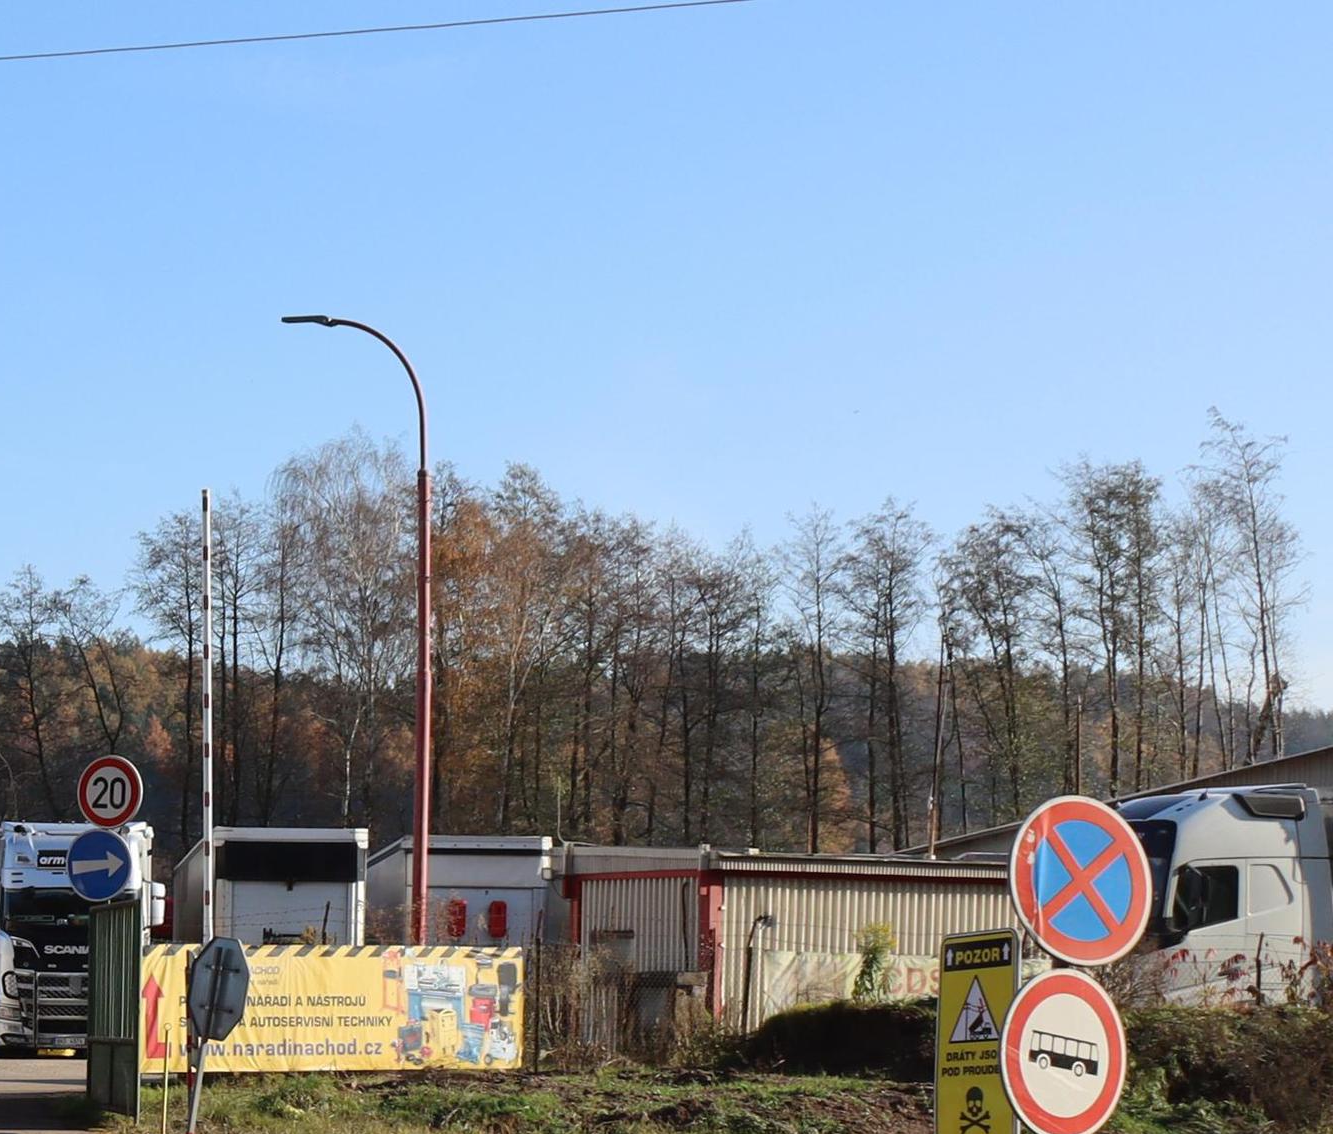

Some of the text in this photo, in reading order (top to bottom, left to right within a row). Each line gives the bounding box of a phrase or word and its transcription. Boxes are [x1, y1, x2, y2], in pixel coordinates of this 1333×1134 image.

[92, 776, 127, 810] 20
[955, 948, 1001, 965] POZOR
[295, 995, 303, 1007] A
[250, 1014, 334, 1028] AUTOSERVISNÍ
[338, 1015, 393, 1027] TECHNIKY
[179, 1038, 383, 1057] w.naradinachod.cz
[946, 1049, 998, 1062] DRÁTY JSO
[941, 1064, 1001, 1077] POD PROUDE
